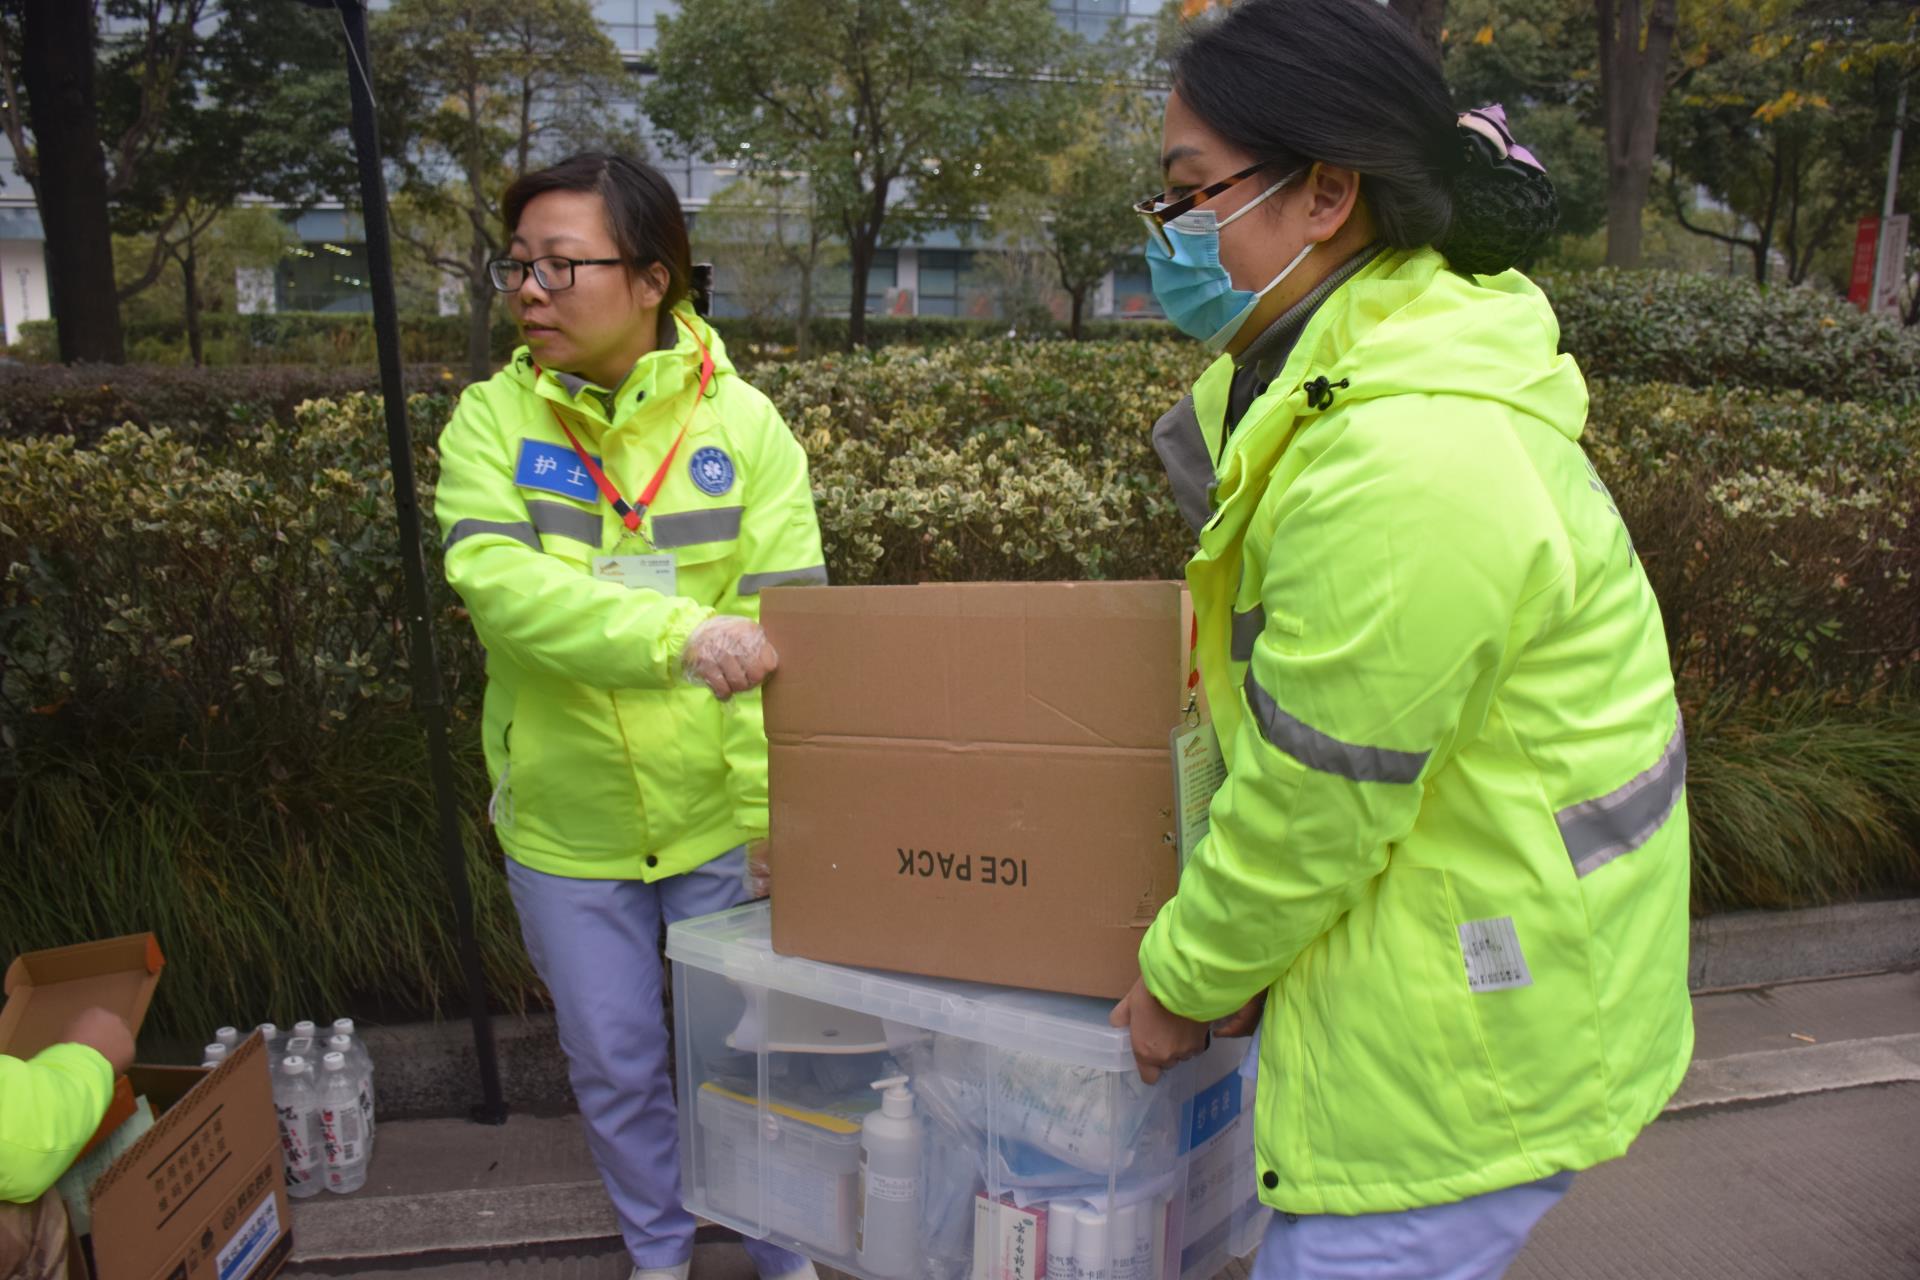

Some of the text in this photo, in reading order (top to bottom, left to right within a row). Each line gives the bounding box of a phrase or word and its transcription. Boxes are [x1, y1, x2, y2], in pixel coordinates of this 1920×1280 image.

[533, 454, 589, 487] 护士
[897, 847, 1028, 888] ICE PACK
